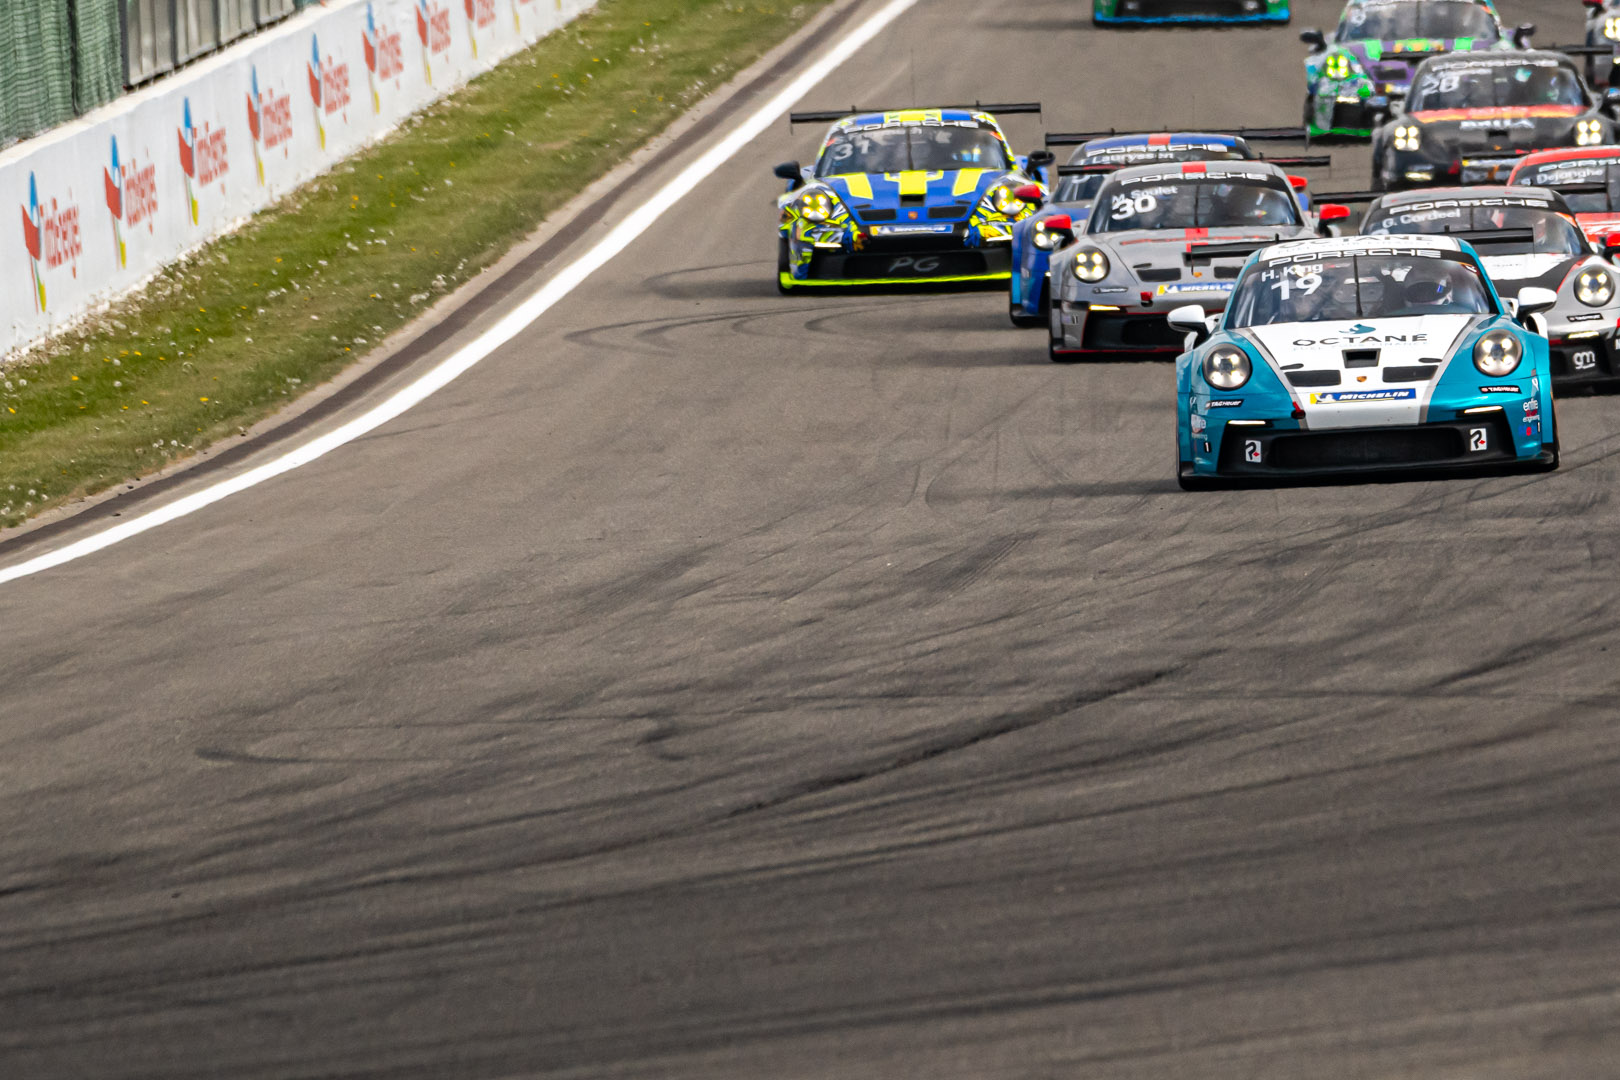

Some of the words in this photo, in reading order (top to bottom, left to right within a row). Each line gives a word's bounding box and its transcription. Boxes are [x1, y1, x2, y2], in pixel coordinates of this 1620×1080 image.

[832, 137, 870, 160] 31
[1087, 143, 1228, 157] PORSCHE
[1120, 172, 1268, 186] PORSCHE
[1111, 194, 1157, 220] 30
[1390, 199, 1549, 215] PORSCHE
[888, 256, 940, 273] PG
[1269, 248, 1441, 268] PORSCHE
[1261, 270, 1279, 282] H.
[1271, 274, 1323, 300] 19
[1292, 333, 1428, 346] OCTANE
[1573, 350, 1596, 370] gm
[1339, 391, 1410, 400] MICHELIN
